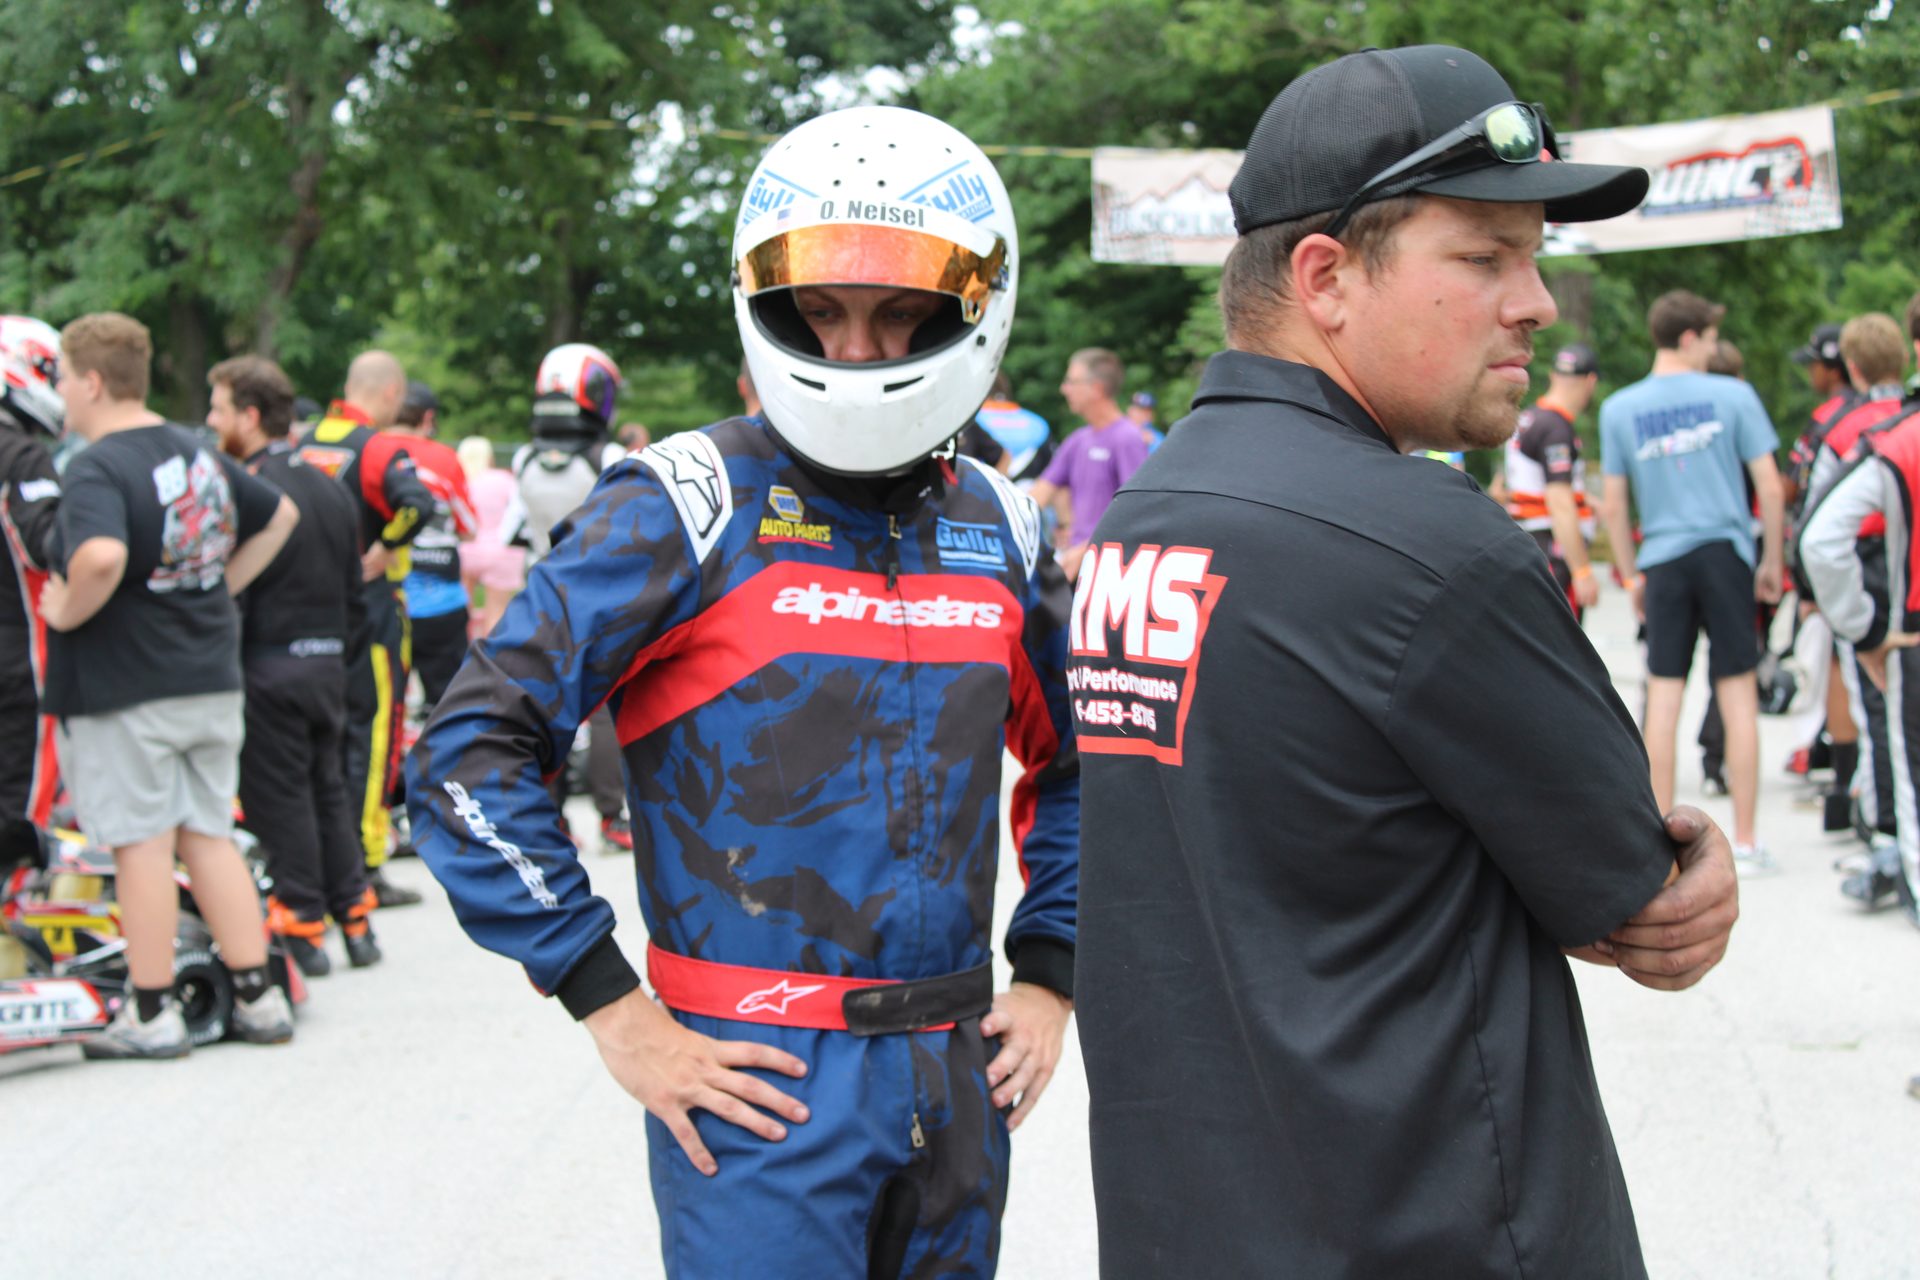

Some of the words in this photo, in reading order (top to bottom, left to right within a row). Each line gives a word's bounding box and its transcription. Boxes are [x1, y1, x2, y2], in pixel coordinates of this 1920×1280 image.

[820, 200, 839, 220] O.
[847, 200, 924, 228] Neisel
[759, 517, 793, 538] AUTO
[793, 523, 832, 543] PARTS
[936, 523, 1006, 564] Gully
[771, 582, 1004, 629] alpinestars
